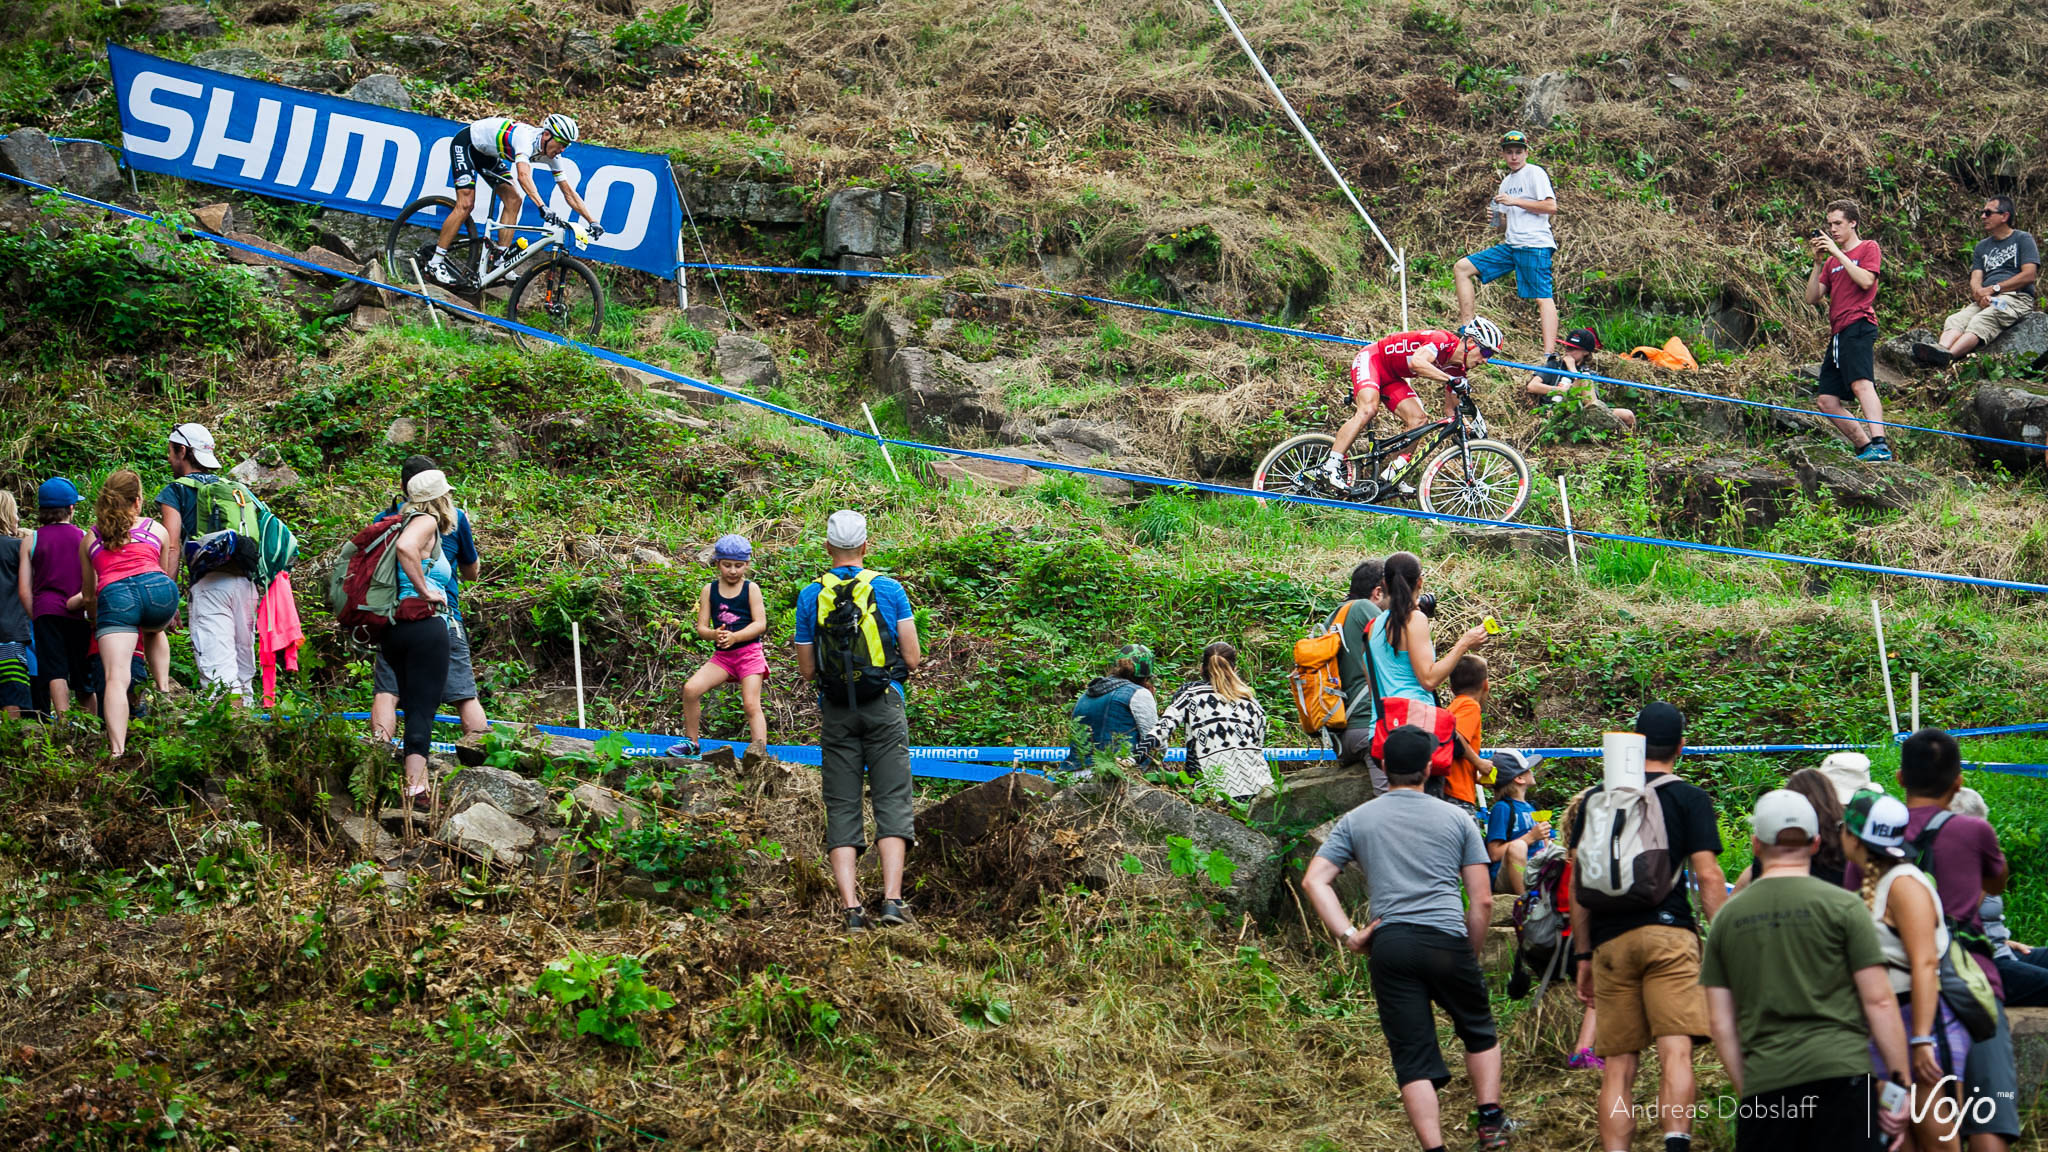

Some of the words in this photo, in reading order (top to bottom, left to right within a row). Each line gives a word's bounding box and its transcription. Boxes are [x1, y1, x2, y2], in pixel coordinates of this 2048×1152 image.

[454, 145, 468, 171] BMC
[504, 251, 528, 269] BMC
[1391, 431, 1441, 487] SCOTT
[908, 747, 979, 759] SHIMANO
[1013, 748, 1071, 760] SHIMA
